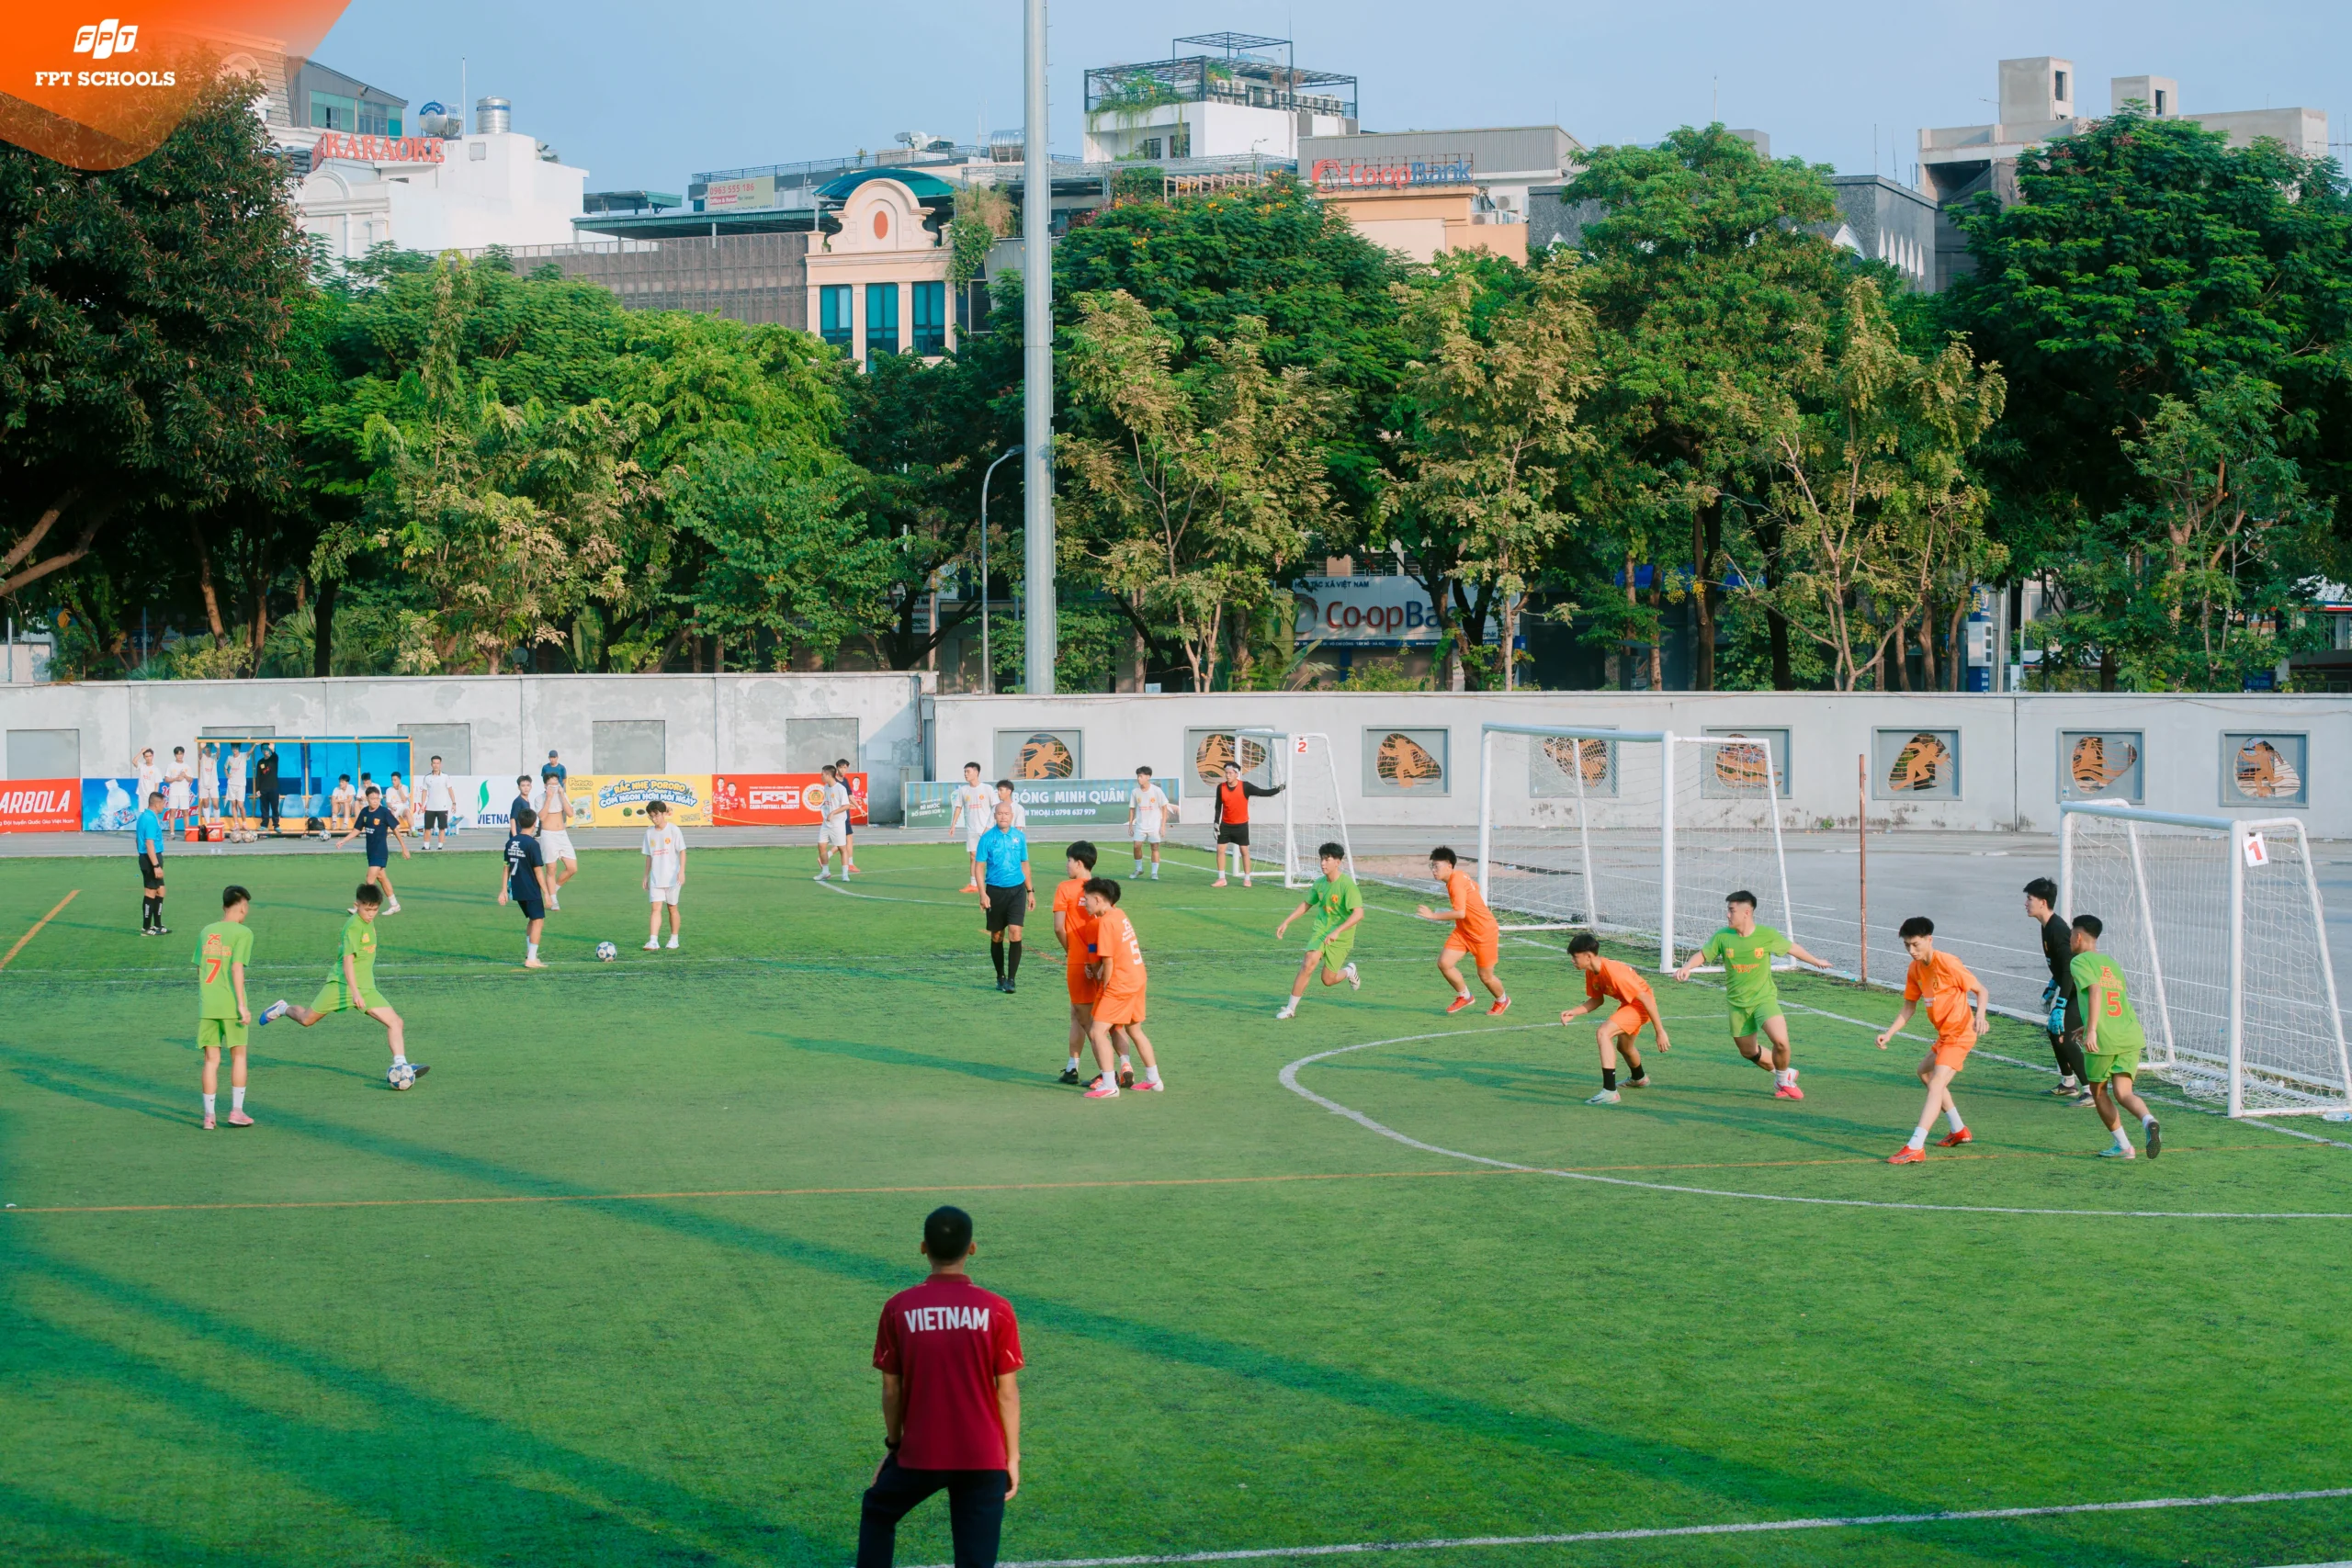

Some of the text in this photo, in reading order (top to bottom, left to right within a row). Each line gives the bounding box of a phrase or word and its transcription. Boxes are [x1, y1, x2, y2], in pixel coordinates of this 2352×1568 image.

[326, 133, 445, 163] KARAOKE
[709, 183, 754, 196] 0963 555 186
[1325, 580, 1335, 588] XÃ
[1336, 580, 1351, 589] VIỆT
[1297, 742, 1306, 752] 2
[613, 780, 686, 794] RẮC NHẸ PORORO
[1012, 787, 1125, 804] BÓNG MINH QUÂN
[0, 790, 70, 814] ARBOLA
[600, 790, 696, 807] CƠM NGON HƠN MỖI NGÀY
[478, 814, 510, 824] VIETNA
[2248, 841, 2262, 861] 1
[510, 858, 519, 875] 7
[208, 933, 221, 945] 25
[1130, 939, 1144, 965] 5
[205, 958, 221, 984] 7
[2107, 991, 2122, 1017] 5
[904, 1306, 989, 1333] VIETNAM
